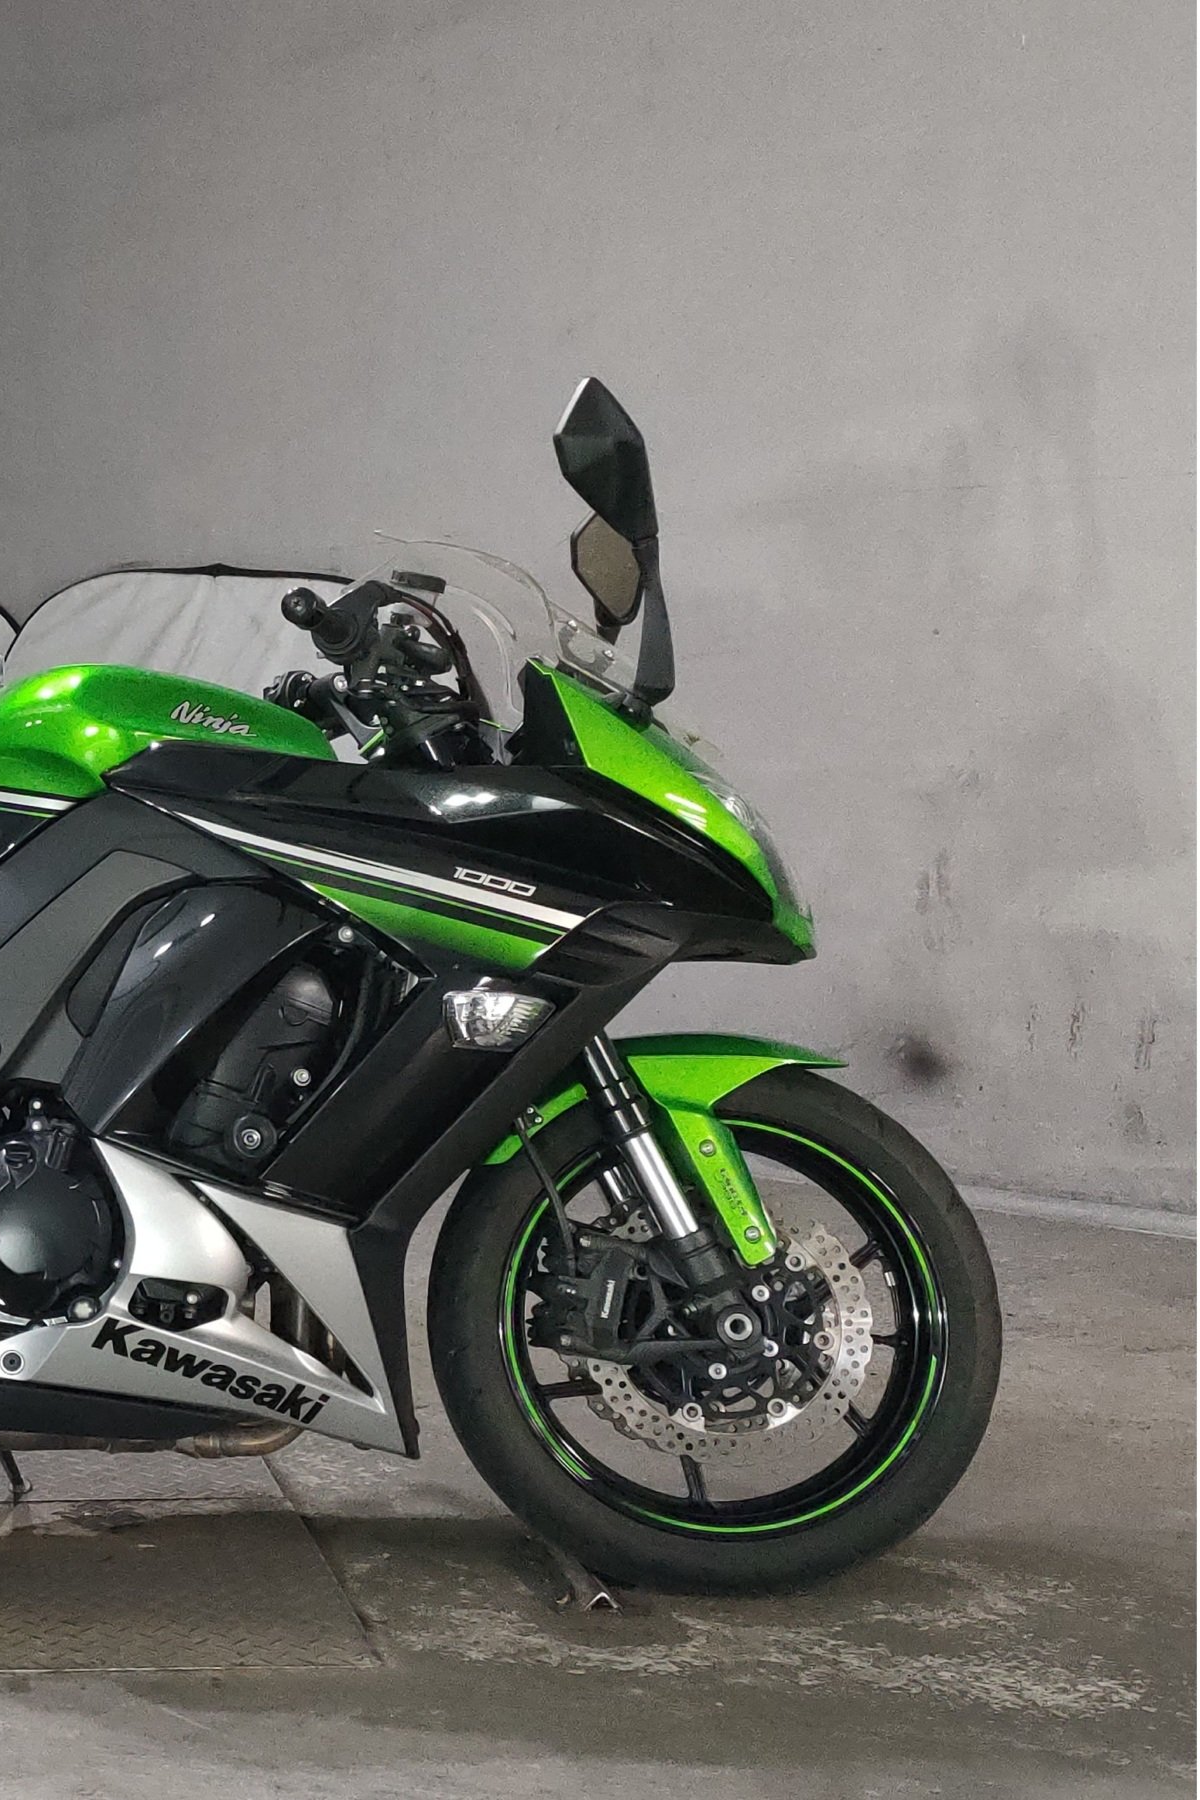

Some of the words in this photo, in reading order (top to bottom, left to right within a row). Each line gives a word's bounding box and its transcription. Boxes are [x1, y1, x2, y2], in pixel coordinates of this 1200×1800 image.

[170, 700, 257, 737] Ninja
[453, 866, 537, 897] 1000
[91, 1317, 330, 1425] Kawasaki
